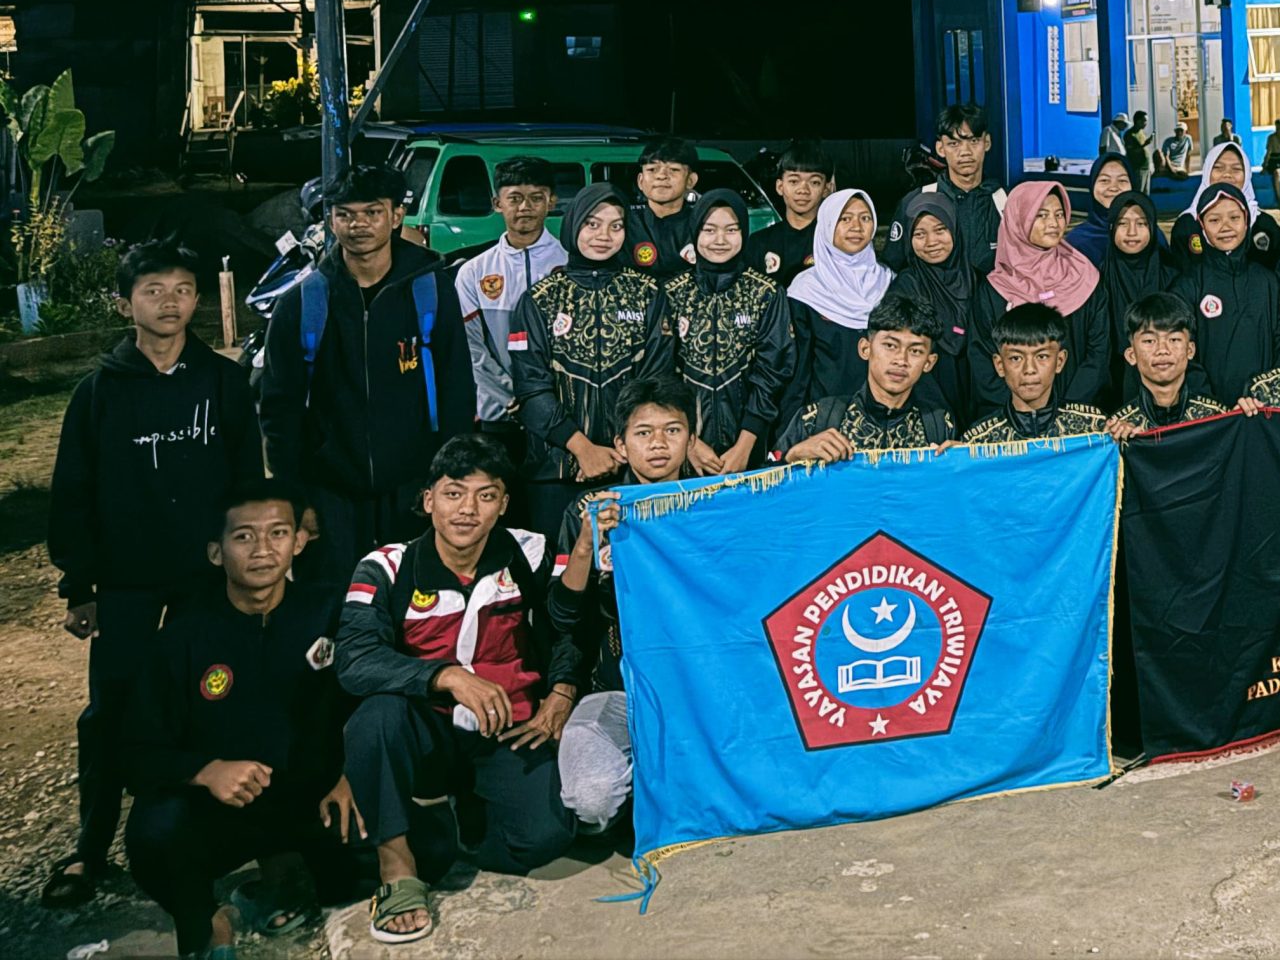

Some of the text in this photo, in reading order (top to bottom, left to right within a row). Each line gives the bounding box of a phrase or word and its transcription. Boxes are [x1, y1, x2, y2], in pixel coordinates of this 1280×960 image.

[963, 416, 999, 440] FIGHTER
[793, 564, 966, 728] YAYASAN PENDIDIKAN TRIWIJAYA
